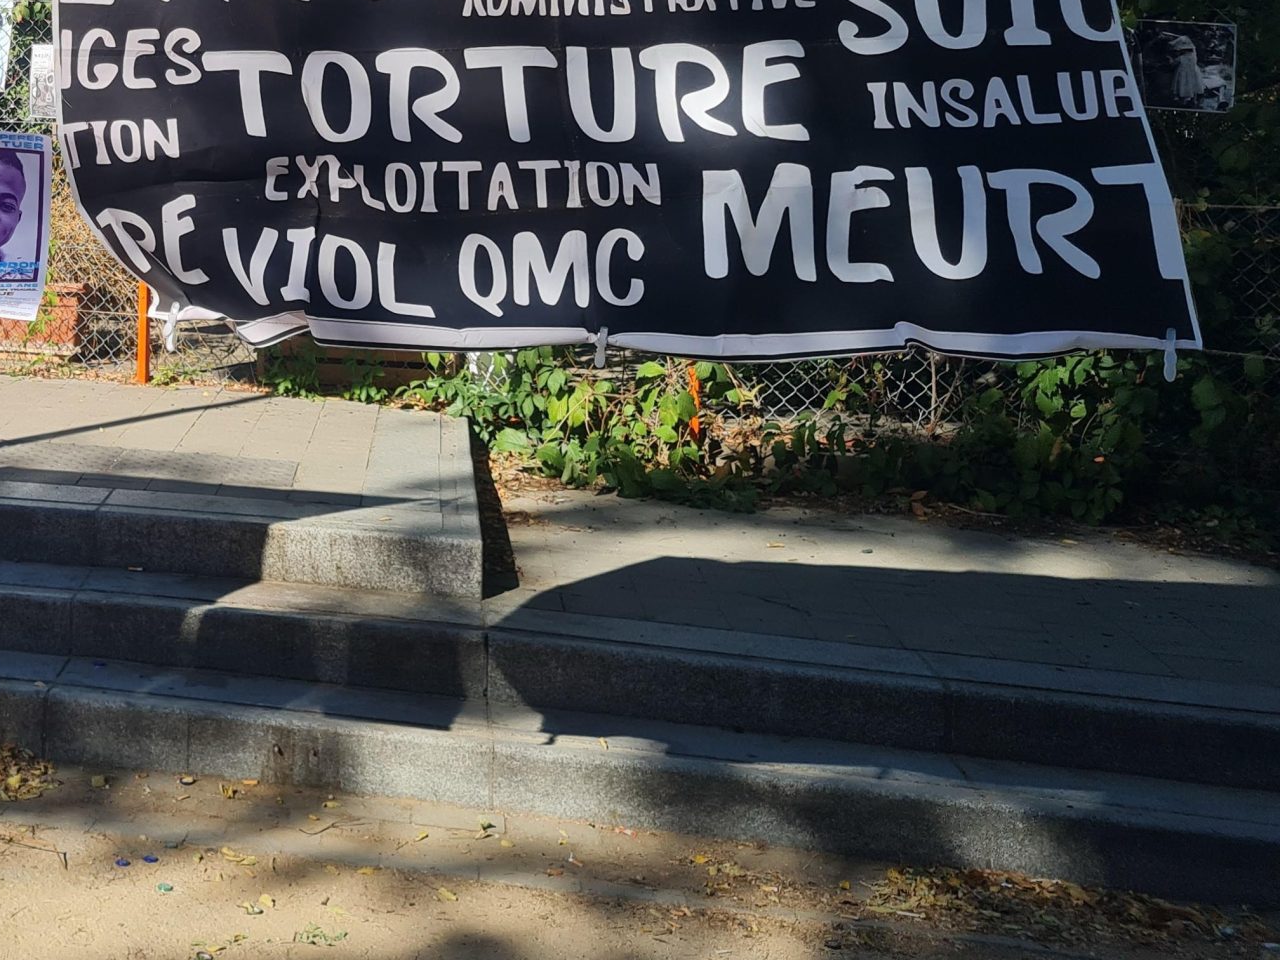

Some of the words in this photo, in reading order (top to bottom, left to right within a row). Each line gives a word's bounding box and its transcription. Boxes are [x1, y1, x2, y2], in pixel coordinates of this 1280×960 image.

[201, 38, 810, 143] TORTURE
[2, 140, 44, 151] TUER
[62, 118, 180, 169] TION
[265, 154, 662, 213] EXPLOITATION
[702, 162, 1185, 283] MEURT
[222, 226, 436, 318] VIOL
[458, 229, 645, 317] QMC
